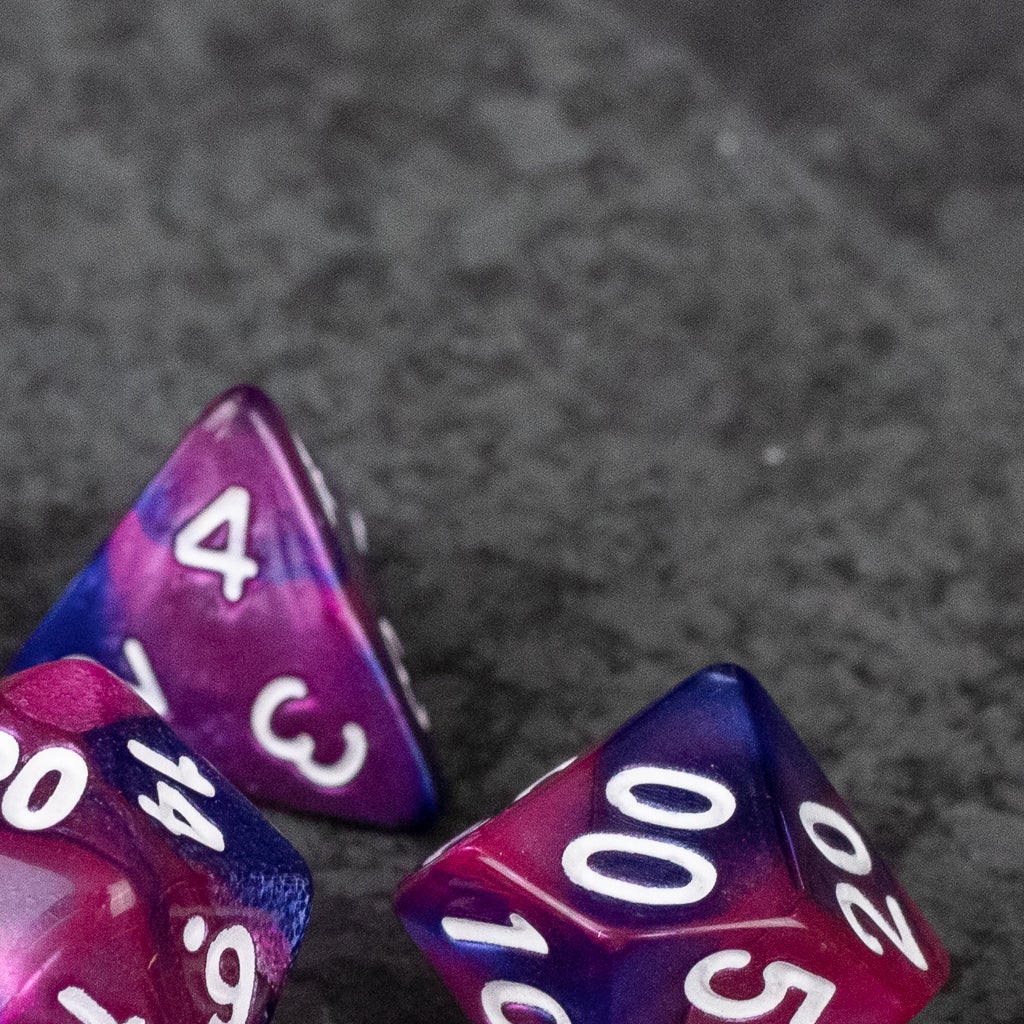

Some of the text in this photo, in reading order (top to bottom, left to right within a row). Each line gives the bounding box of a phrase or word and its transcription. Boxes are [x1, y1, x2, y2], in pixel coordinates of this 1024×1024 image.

[175, 486, 258, 602] 4
[250, 676, 368, 788] 3
[127, 739, 225, 852] 14
[561, 765, 737, 906] 00
[798, 801, 929, 971] 20
